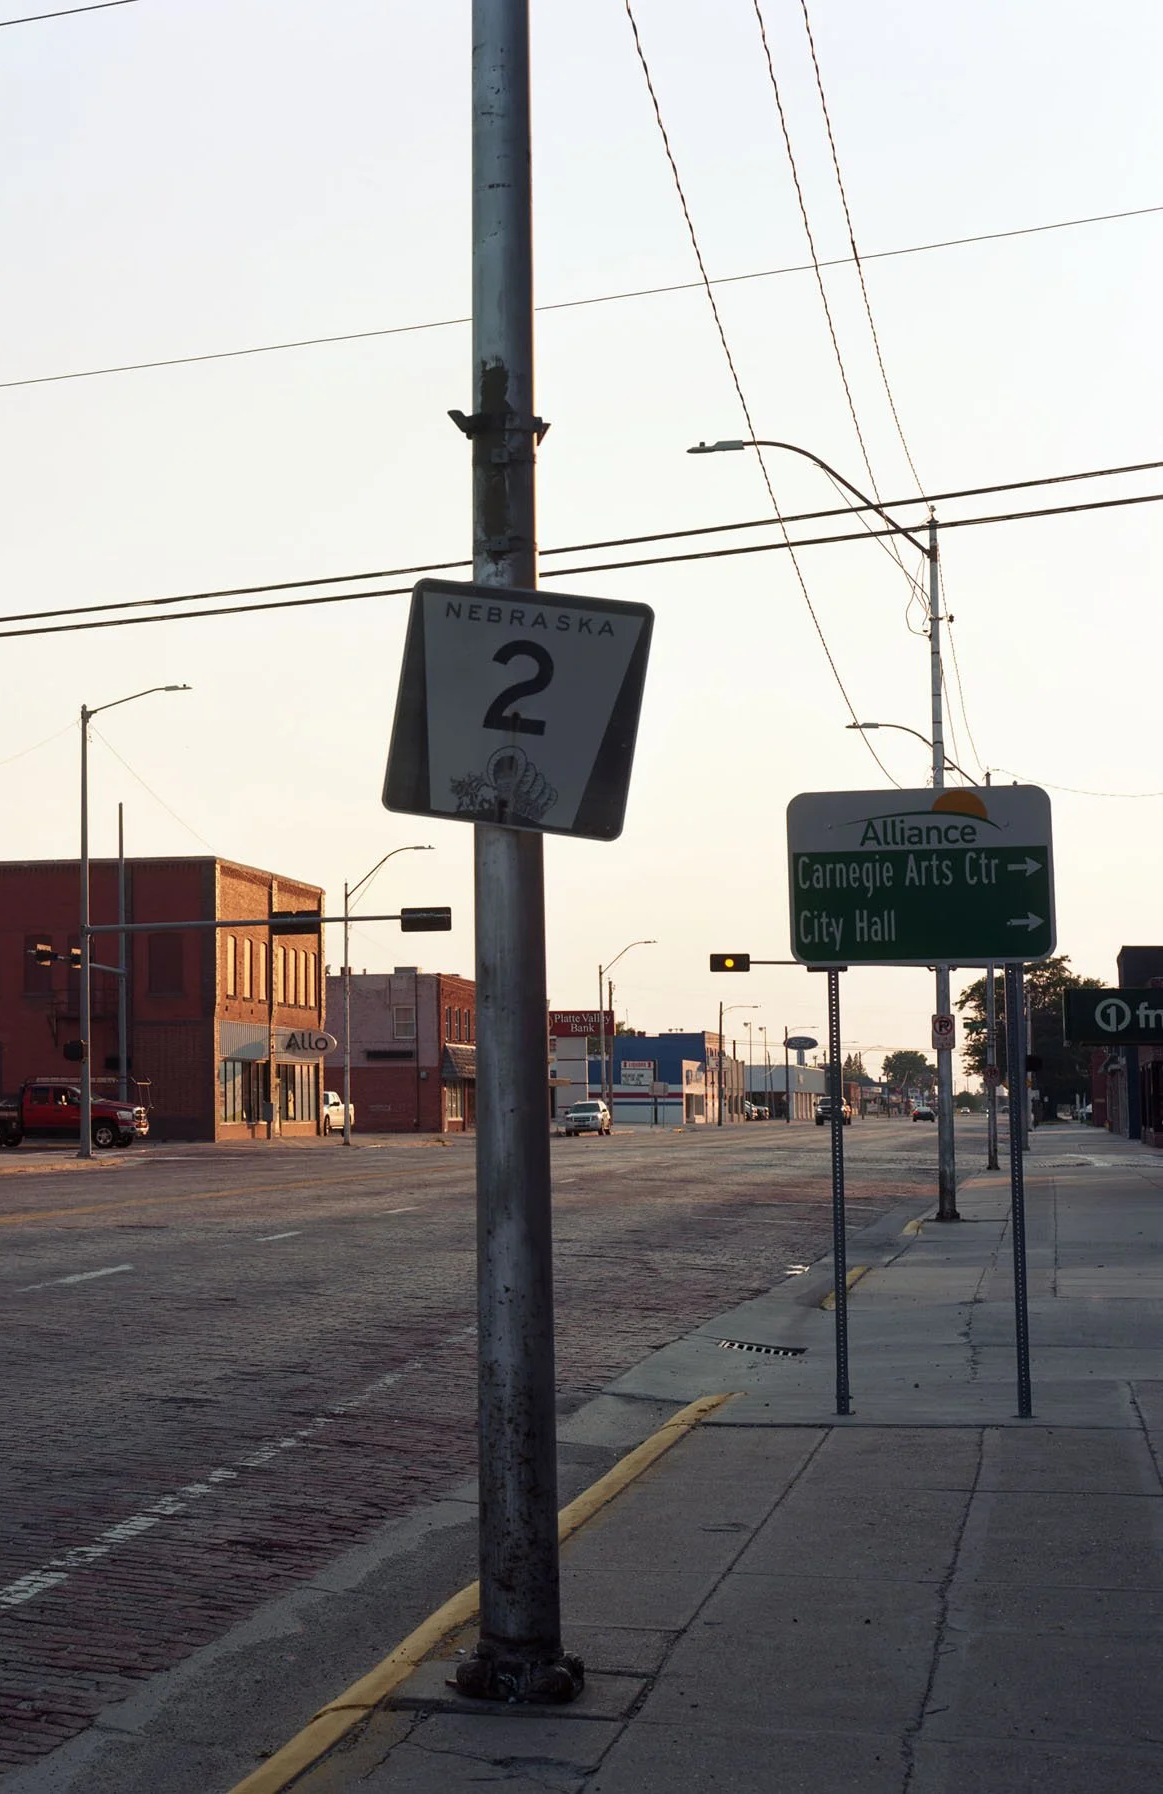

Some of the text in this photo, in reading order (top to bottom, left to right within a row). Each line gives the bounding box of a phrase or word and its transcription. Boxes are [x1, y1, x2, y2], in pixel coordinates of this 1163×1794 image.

[445, 602, 615, 637] NEBRASKA
[482, 639, 555, 736] 2
[860, 819, 977, 847] Alliance
[797, 851, 999, 898] Carnegie Arts Ctr
[799, 909, 896, 951] City Hall
[554, 1013, 580, 1023] Platte
[571, 1023, 595, 1033] Bank
[285, 1032, 328, 1051] Allo
